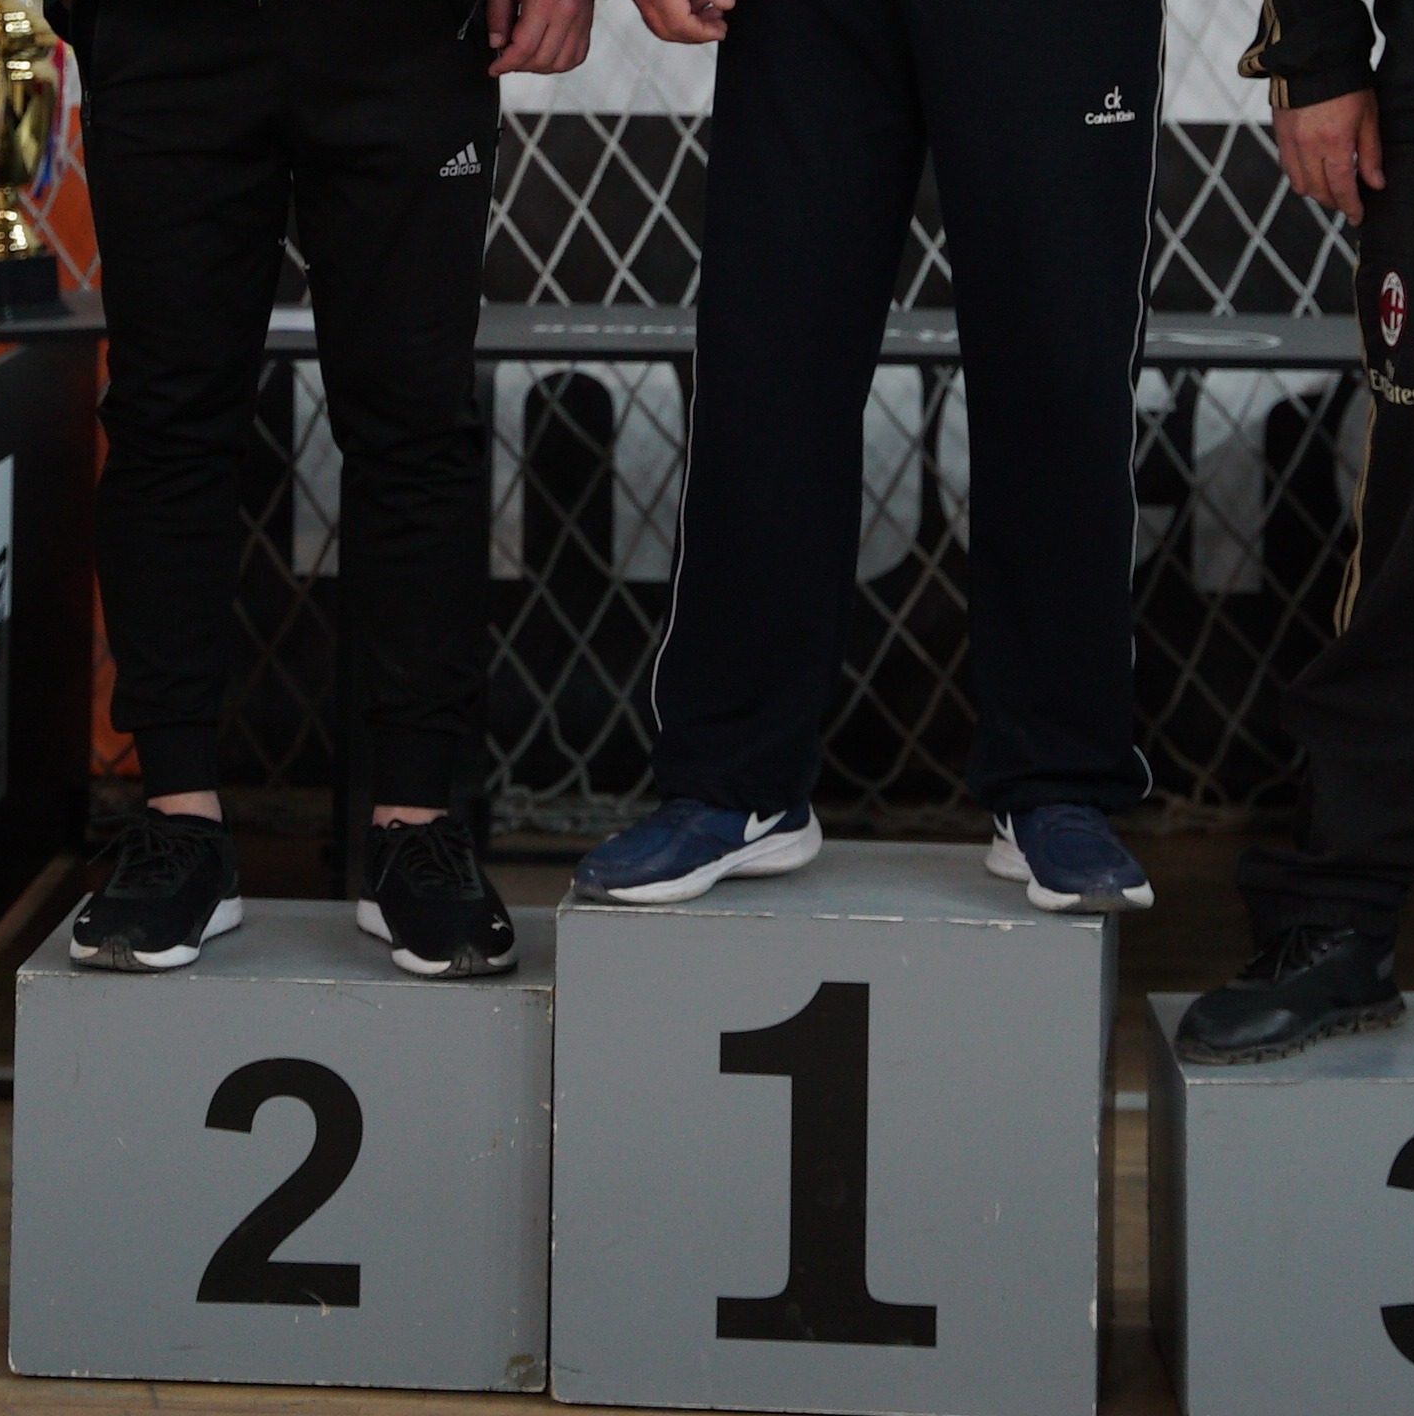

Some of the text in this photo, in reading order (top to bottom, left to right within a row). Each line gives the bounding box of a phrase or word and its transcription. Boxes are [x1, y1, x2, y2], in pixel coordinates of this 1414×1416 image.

[439, 163, 482, 178] adidas
[1084, 111, 1116, 125] Calvin
[196, 1056, 364, 1307] 2
[715, 981, 937, 1347] 1
